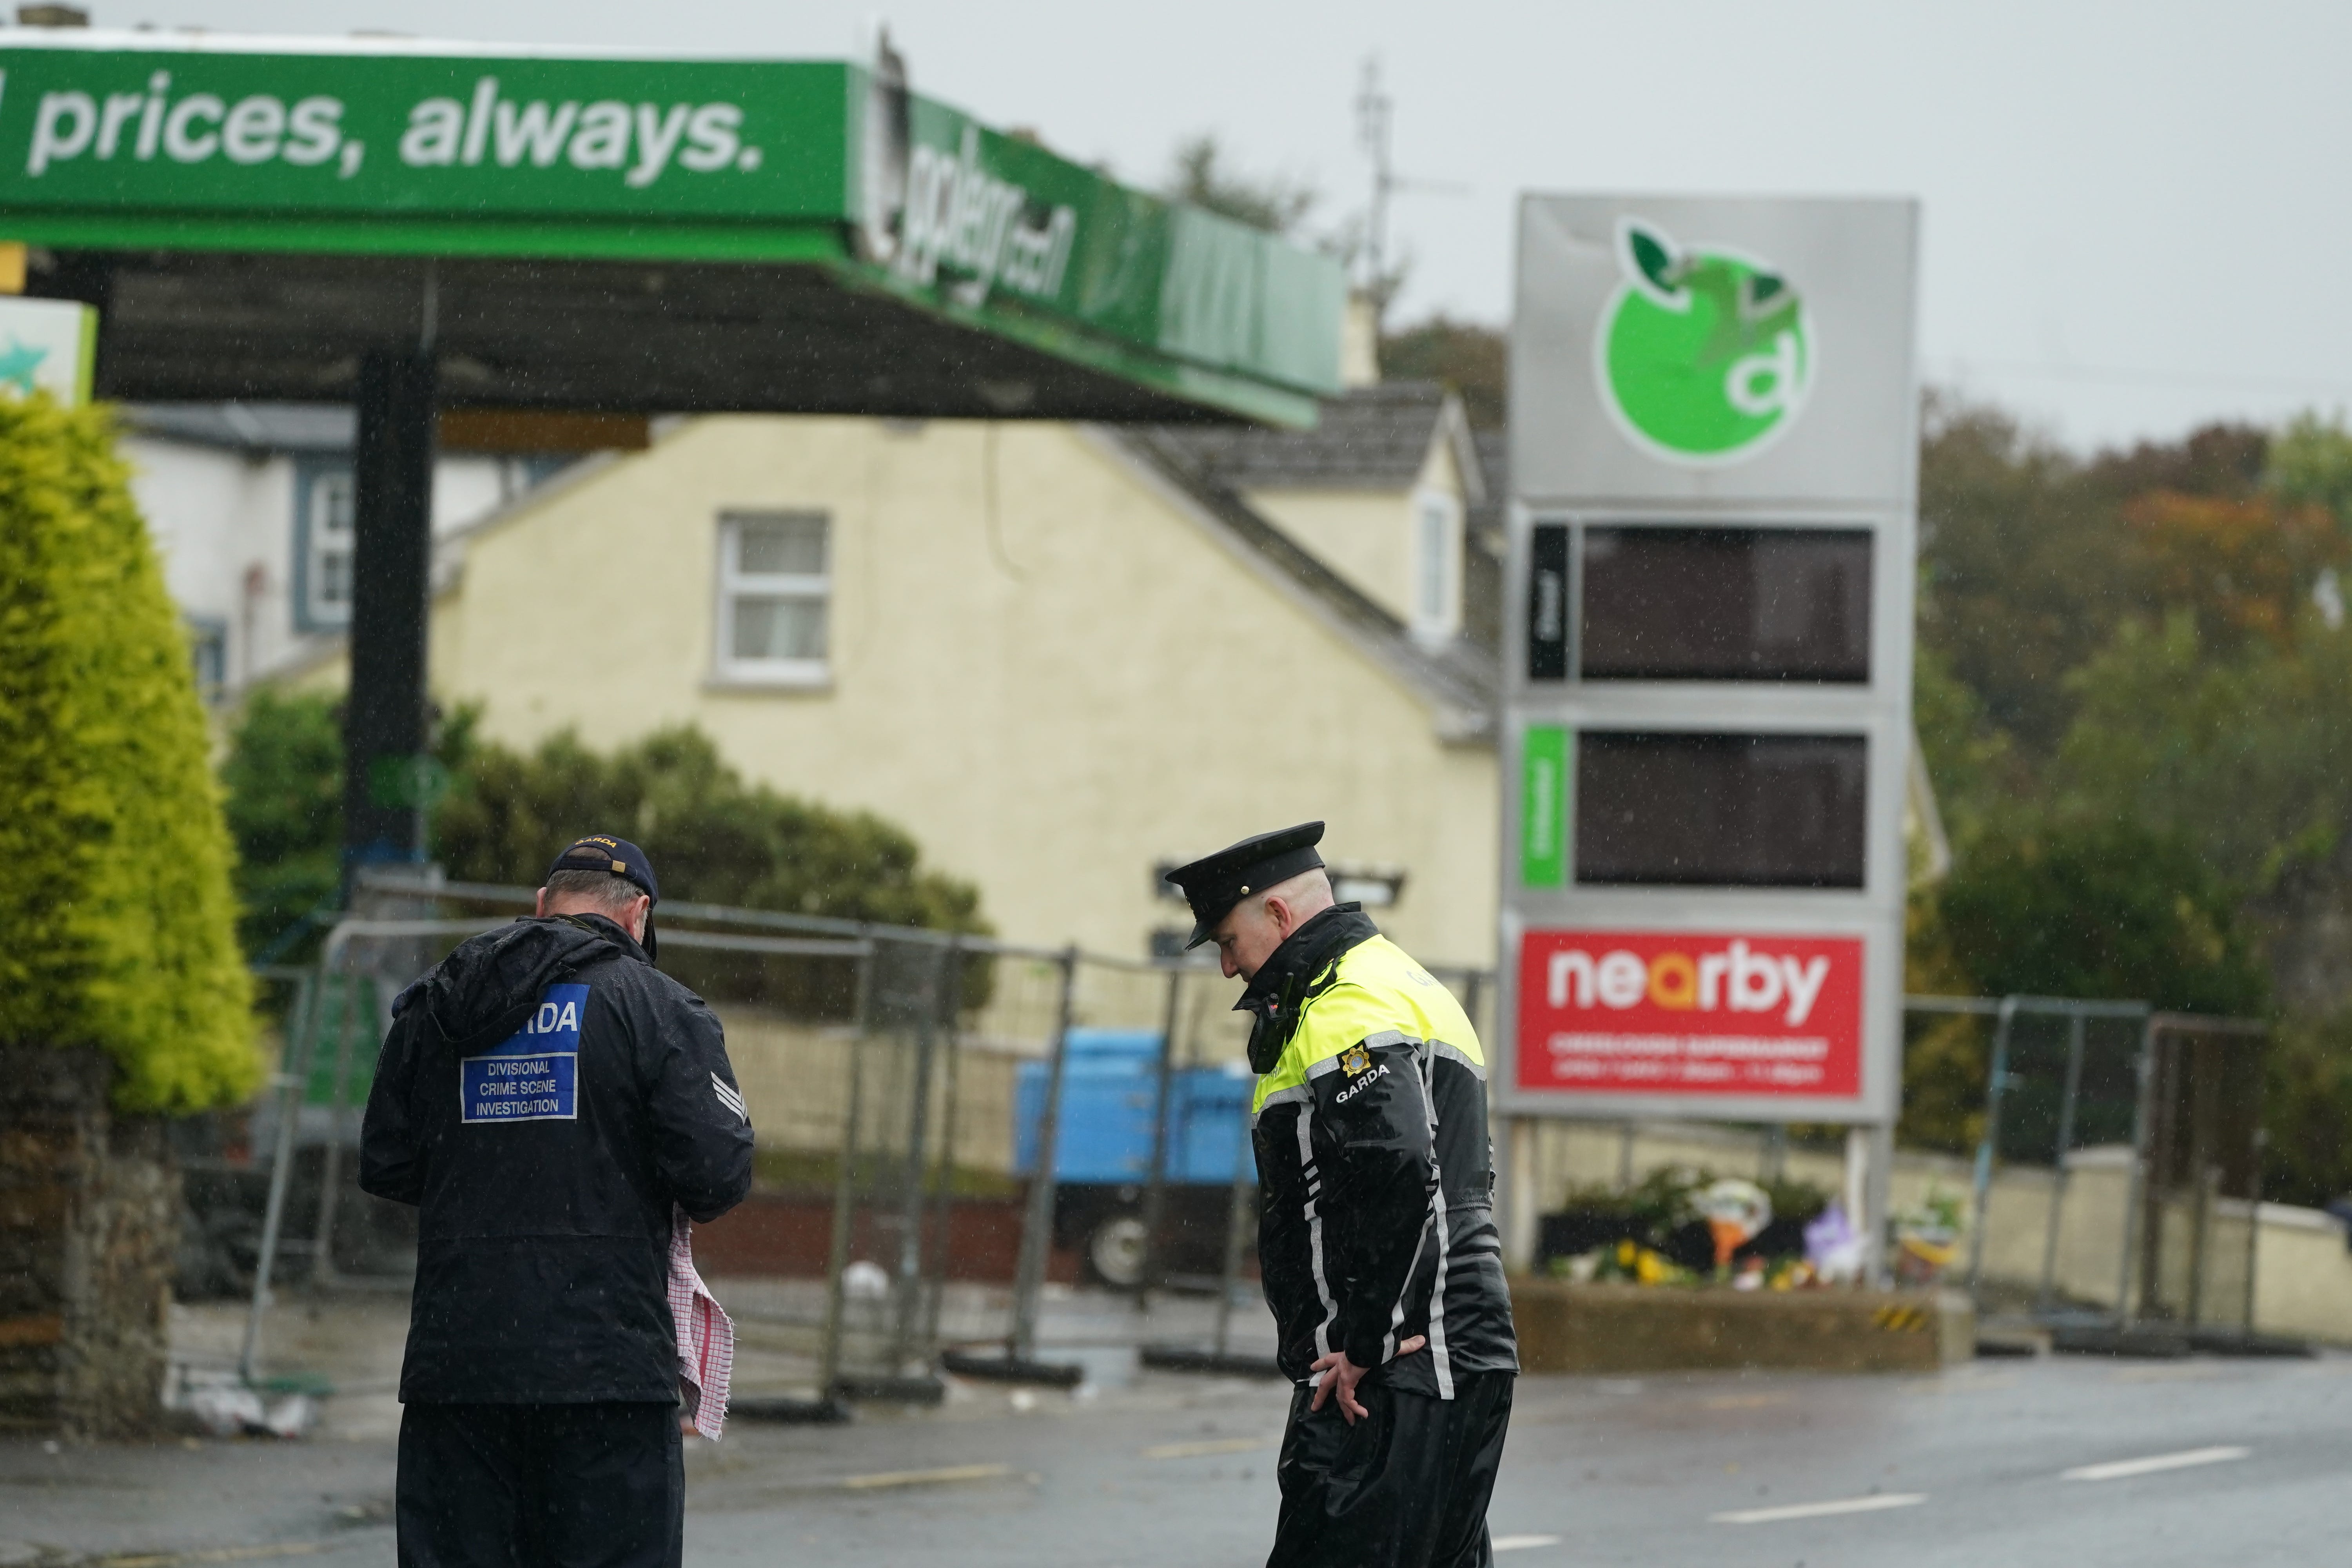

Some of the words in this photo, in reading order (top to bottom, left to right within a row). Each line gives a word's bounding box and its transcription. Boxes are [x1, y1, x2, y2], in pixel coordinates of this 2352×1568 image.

[27, 71, 364, 176] prices,
[400, 76, 764, 187] always.
[575, 837, 617, 848] GARDA
[1547, 938, 1831, 1027] nearby
[488, 1061, 550, 1076] DIVISIONAL
[480, 1082, 517, 1096] CRIME
[520, 1079, 556, 1094] SCENE
[1336, 1064, 1390, 1103] GARDA
[477, 1099, 559, 1116] INVESTIGATION
